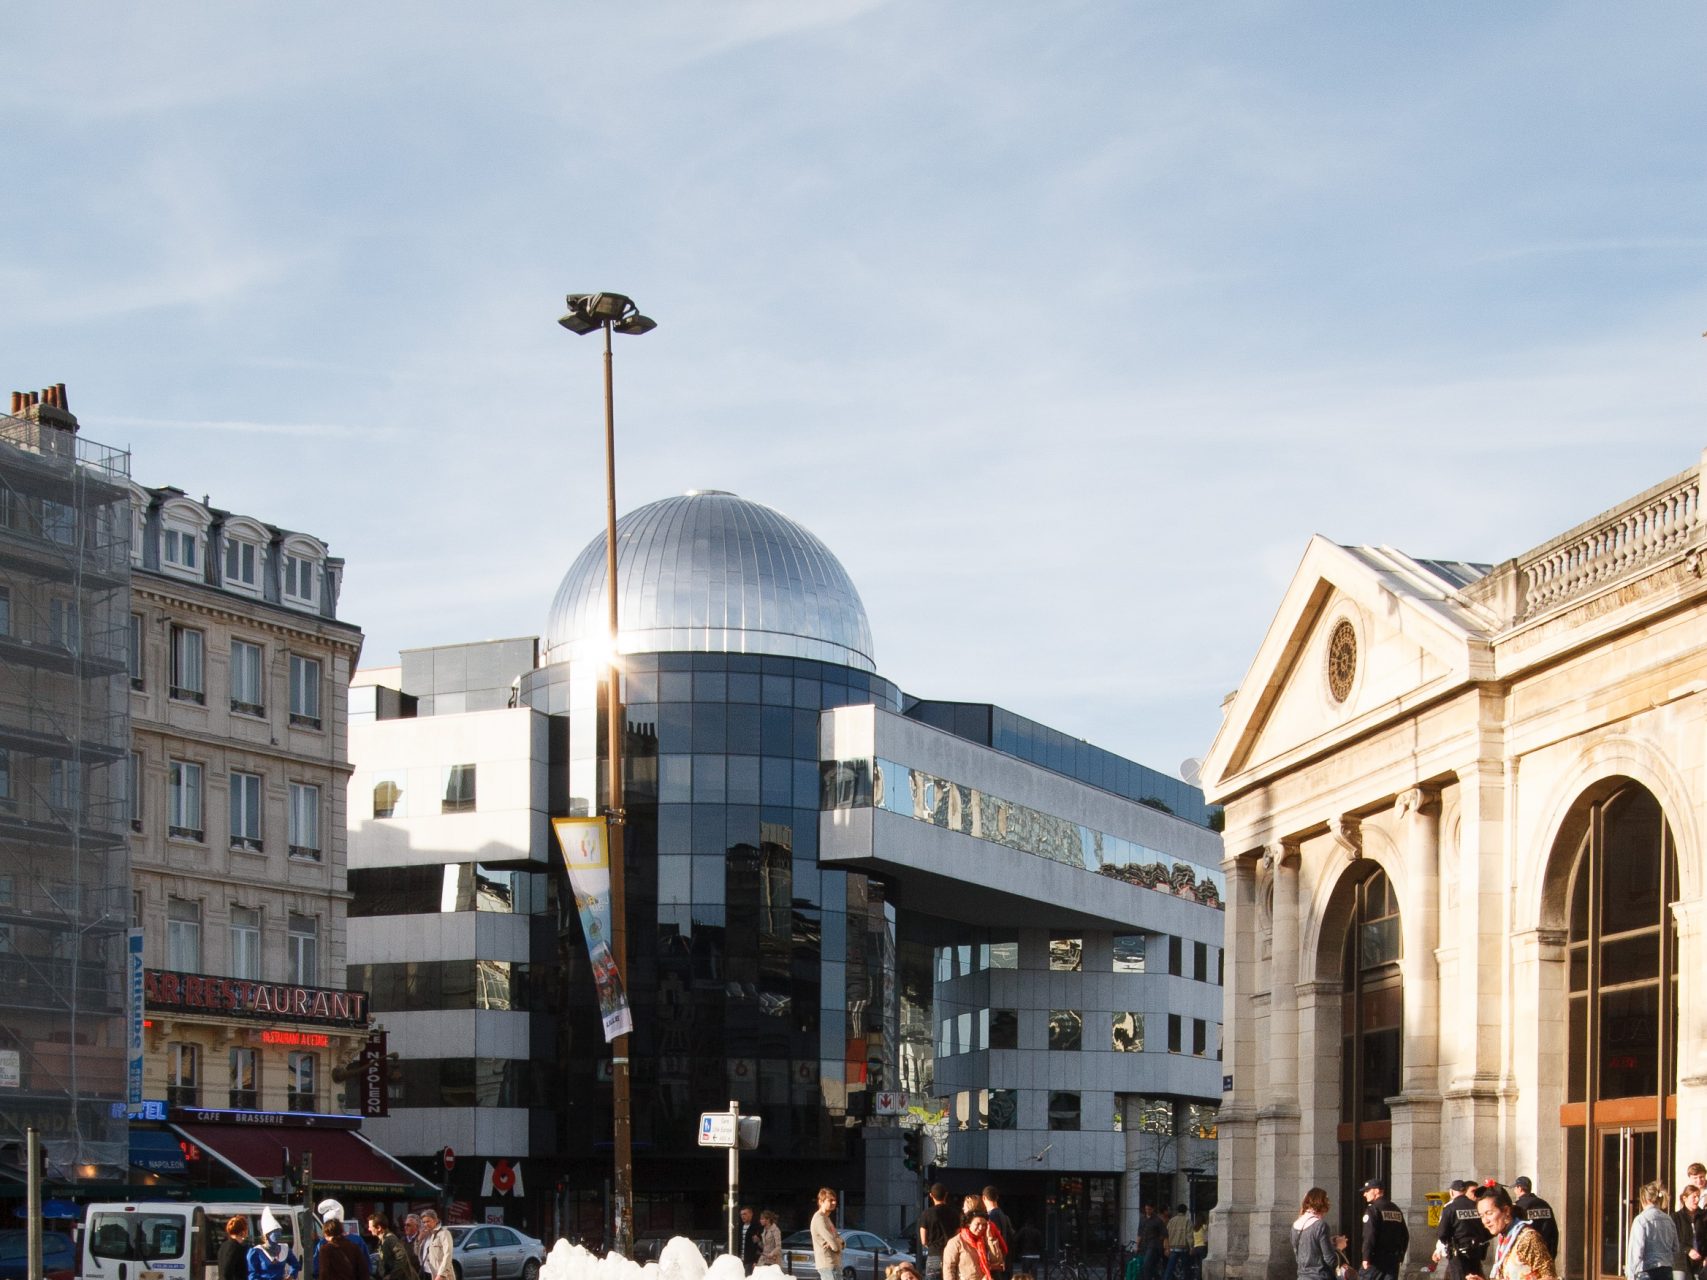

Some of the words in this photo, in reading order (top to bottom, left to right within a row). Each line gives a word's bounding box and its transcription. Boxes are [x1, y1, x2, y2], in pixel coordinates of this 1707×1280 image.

[185, 975, 365, 1020] RESTAURANT
[367, 1051, 381, 1114] NAPOLEON
[236, 1113, 284, 1124] BRASSERIE
[148, 1160, 185, 1169] NAPOLEON
[1458, 1210, 1481, 1219] POLIC
[1528, 1209, 1551, 1218] POLICE
